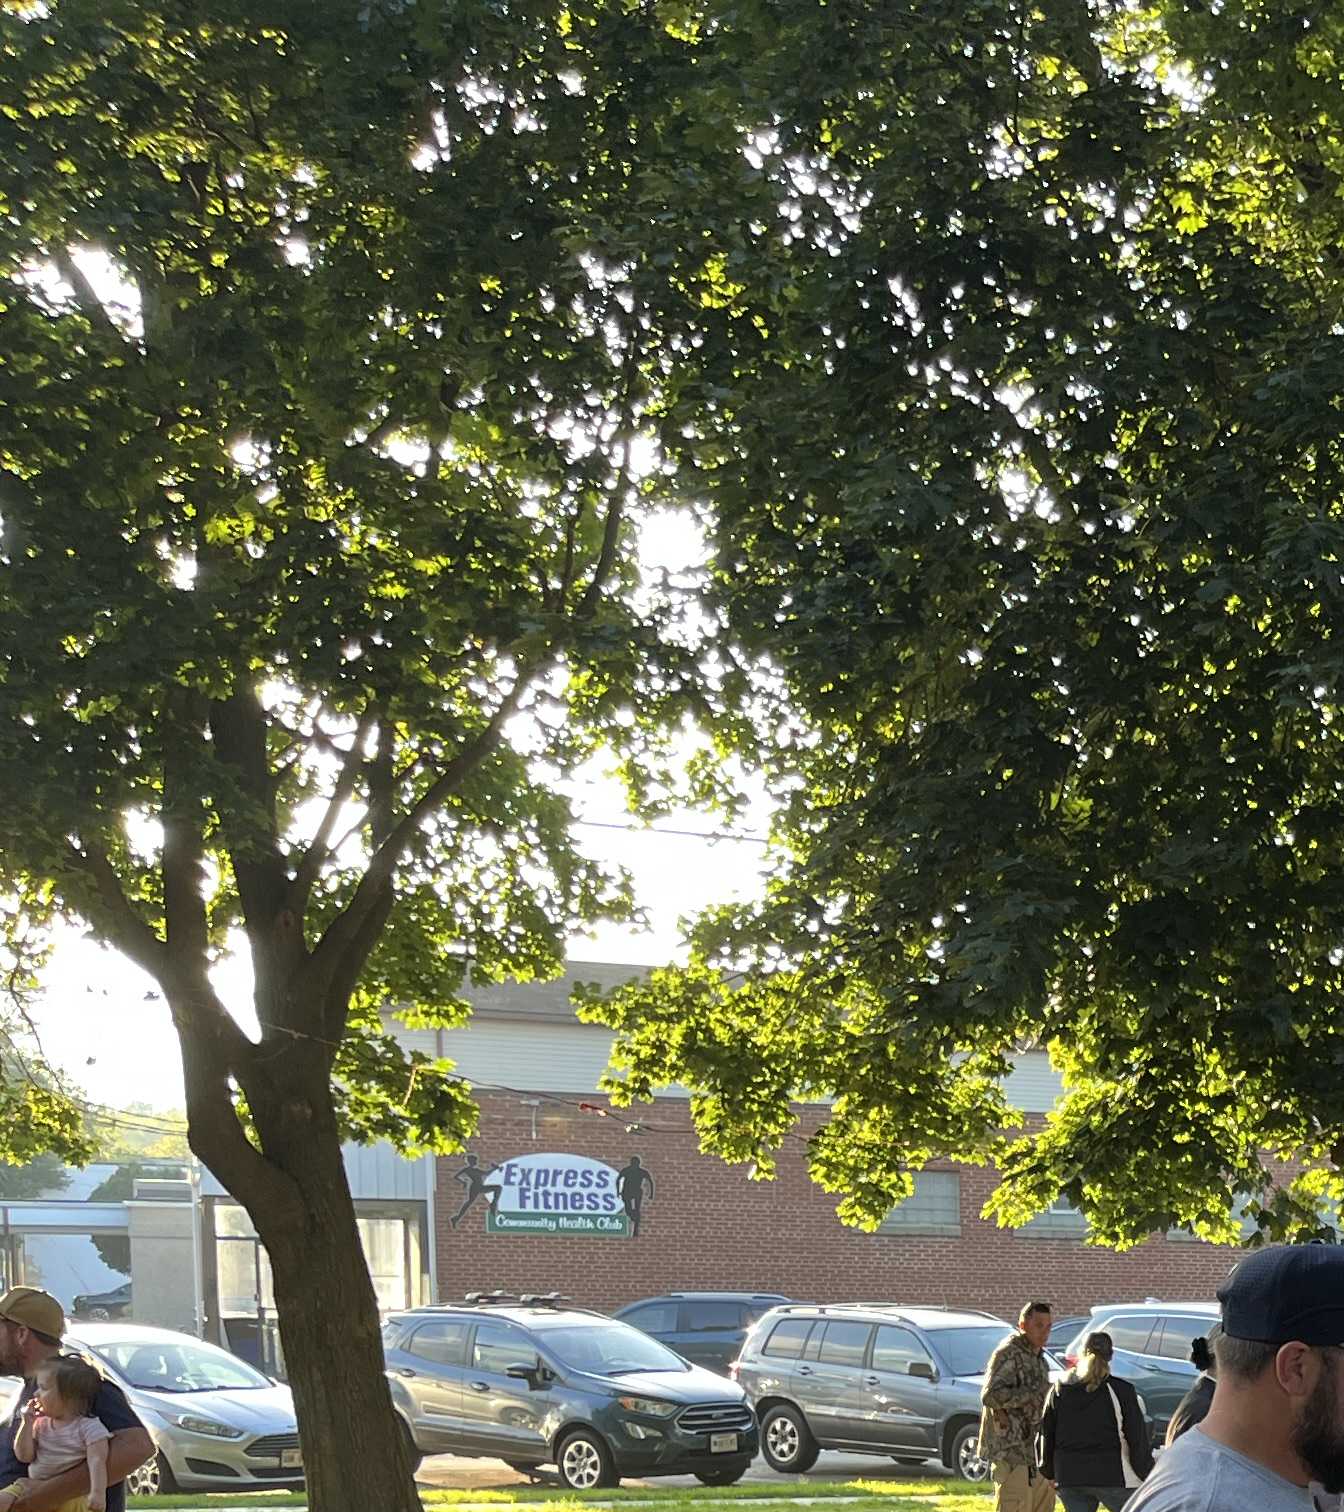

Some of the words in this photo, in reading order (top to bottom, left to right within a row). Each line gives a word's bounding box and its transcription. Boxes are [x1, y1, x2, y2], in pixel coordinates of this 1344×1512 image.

[503, 1163, 610, 1189] Express
[518, 1187, 616, 1211] Fitness
[495, 1214, 556, 1231] Community
[559, 1216, 595, 1229] Health
[597, 1216, 622, 1230] Club
